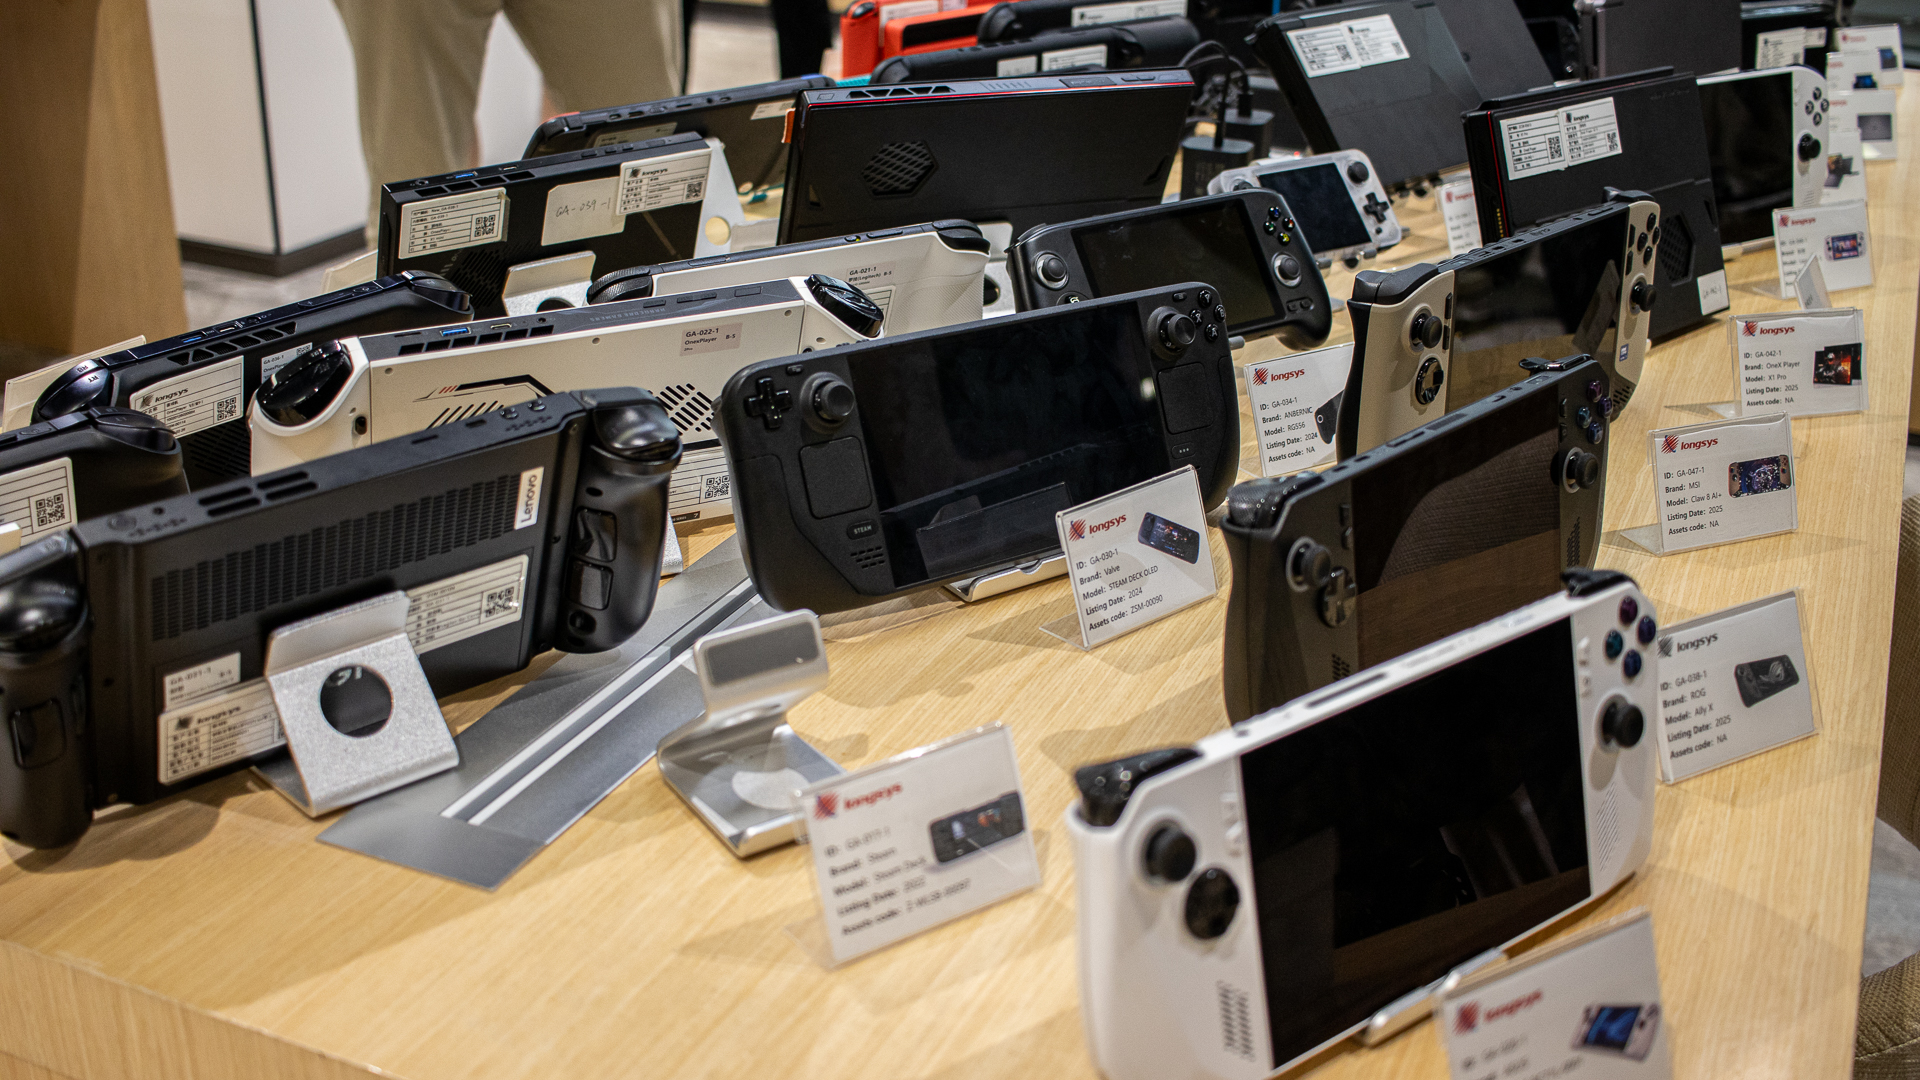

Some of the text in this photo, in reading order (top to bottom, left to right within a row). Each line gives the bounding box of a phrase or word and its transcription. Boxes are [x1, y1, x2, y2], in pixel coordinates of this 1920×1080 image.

[642, 167, 668, 176] longsys
[849, 267, 877, 275] GA-021-1
[685, 328, 719, 338] GA-022-1
[1760, 326, 1795, 336] longsys
[685, 336, 717, 345] OnexPlayer
[1755, 350, 1782, 358] GA-042-1
[1783, 361, 1800, 369] Player
[1271, 368, 1305, 382] longsys
[154, 387, 189, 403] longsys
[1272, 397, 1298, 408] GA-034-1
[1262, 407, 1313, 424] Brand: ANBERNIC
[1264, 427, 1285, 436] Model:
[1266, 432, 1318, 450] Listing Date: 2024
[1681, 437, 1718, 450] longsys
[1268, 454, 1287, 463] Assets
[1287, 450, 1303, 458] code:
[1664, 467, 1705, 479] ID: GA-047-1
[1665, 481, 1700, 493] Brand: MSI
[521, 474, 537, 523] Lenovo
[1666, 498, 1688, 507] Model:
[1691, 495, 1705, 503] Claw
[1711, 492, 1722, 500] AI+
[1667, 505, 1723, 522] Listing Date: 2025
[854, 525, 872, 534] STEAM
[1089, 514, 1127, 535] longsys
[1669, 525, 1688, 535] Assets
[1689, 523, 1706, 531] code:
[1076, 548, 1118, 570] ID: GA-030-1
[1079, 564, 1120, 585] Brand: Valve
[1082, 565, 1158, 601] Model: STEAM DECK OLED
[1085, 587, 1143, 616] Listing Date: 2024
[1089, 594, 1163, 631] Assets code: ZSM-00090
[1677, 632, 1718, 653] longsys
[1660, 670, 1708, 691] ID: GA-038-1
[1663, 688, 1706, 709] Brand: ROG
[1665, 703, 1714, 725] Model: Ally X
[1667, 715, 1731, 743] Listing Date: 2025
[1670, 734, 1728, 759] Assets code: NA
[843, 782, 903, 810] longsys
